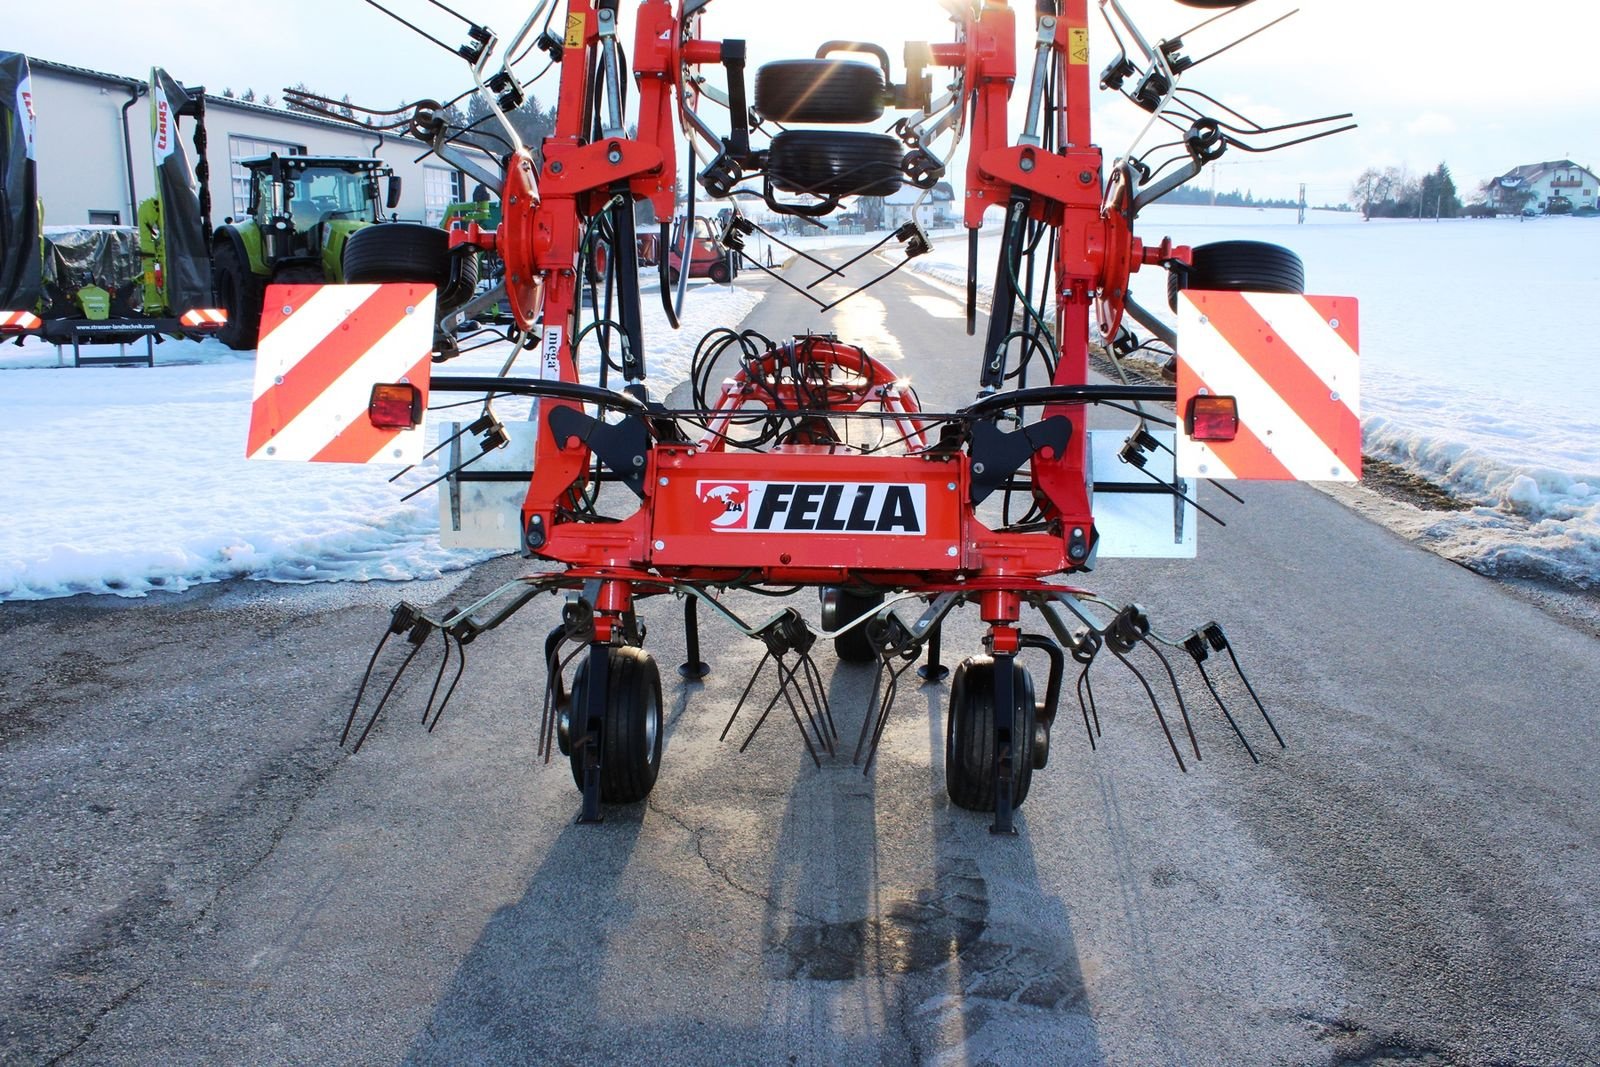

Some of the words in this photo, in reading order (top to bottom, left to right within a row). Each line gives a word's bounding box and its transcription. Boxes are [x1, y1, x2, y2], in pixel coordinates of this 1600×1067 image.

[157, 101, 167, 150] CLAAS
[544, 332, 557, 369] mega
[753, 484, 921, 532] FELLA
